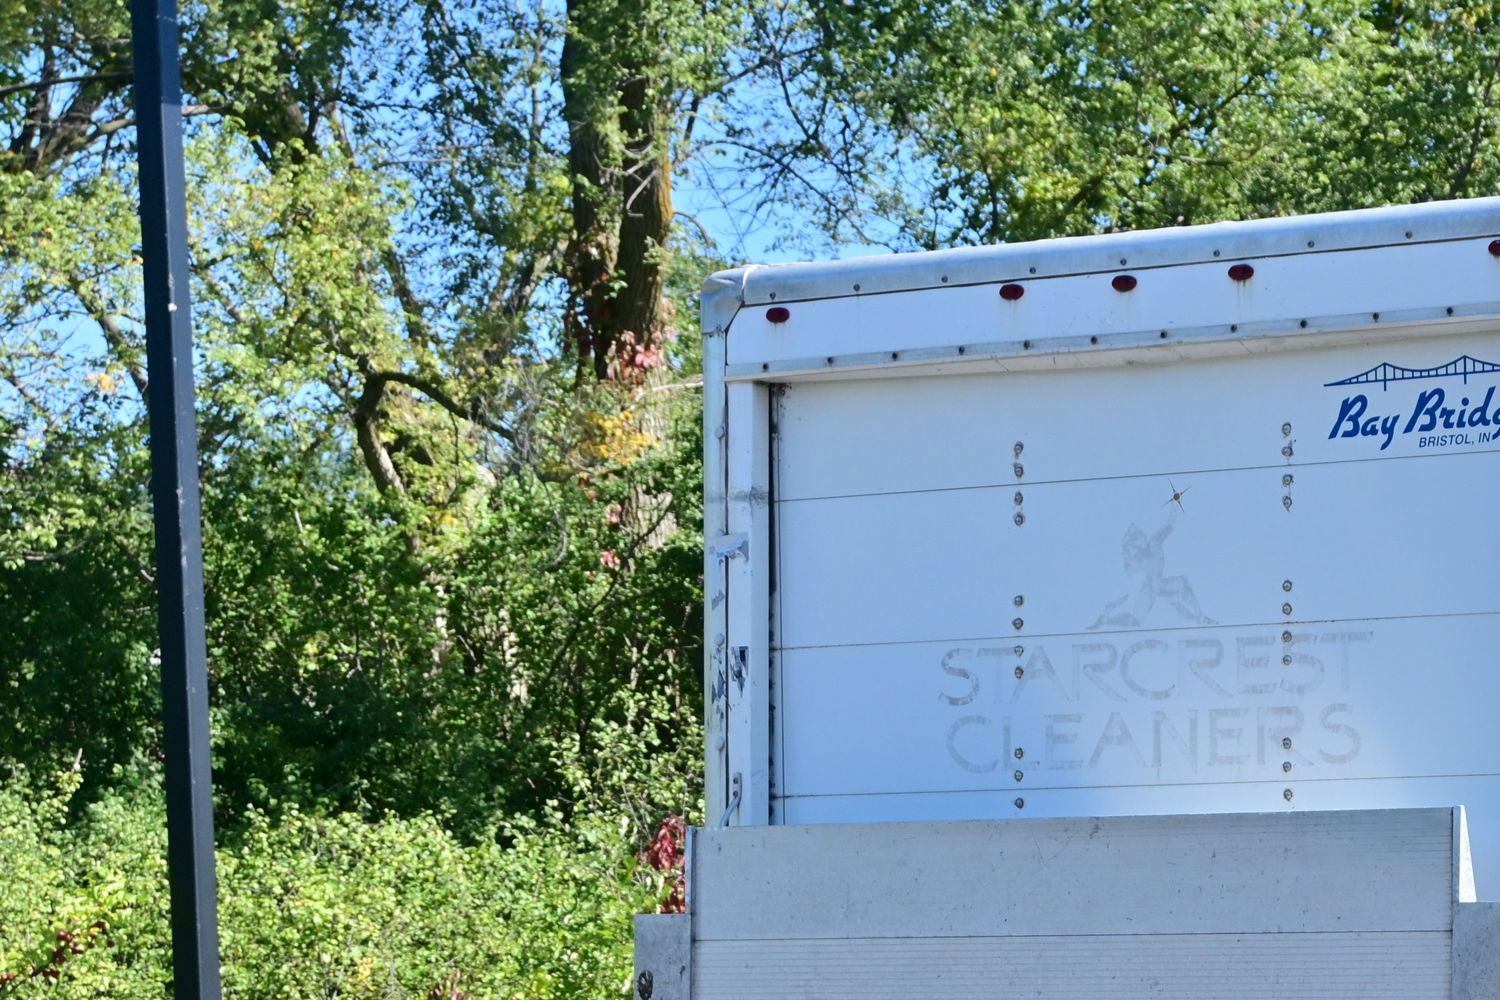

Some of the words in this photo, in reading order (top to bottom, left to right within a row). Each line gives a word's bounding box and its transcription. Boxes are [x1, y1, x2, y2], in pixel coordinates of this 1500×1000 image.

[1328, 394, 1400, 450] Bay
[1418, 434, 1475, 448] BRISTOL,
[1478, 432, 1491, 444] IN
[938, 630, 1374, 707] STARCREST
[946, 702, 1362, 774] CLEANERS
